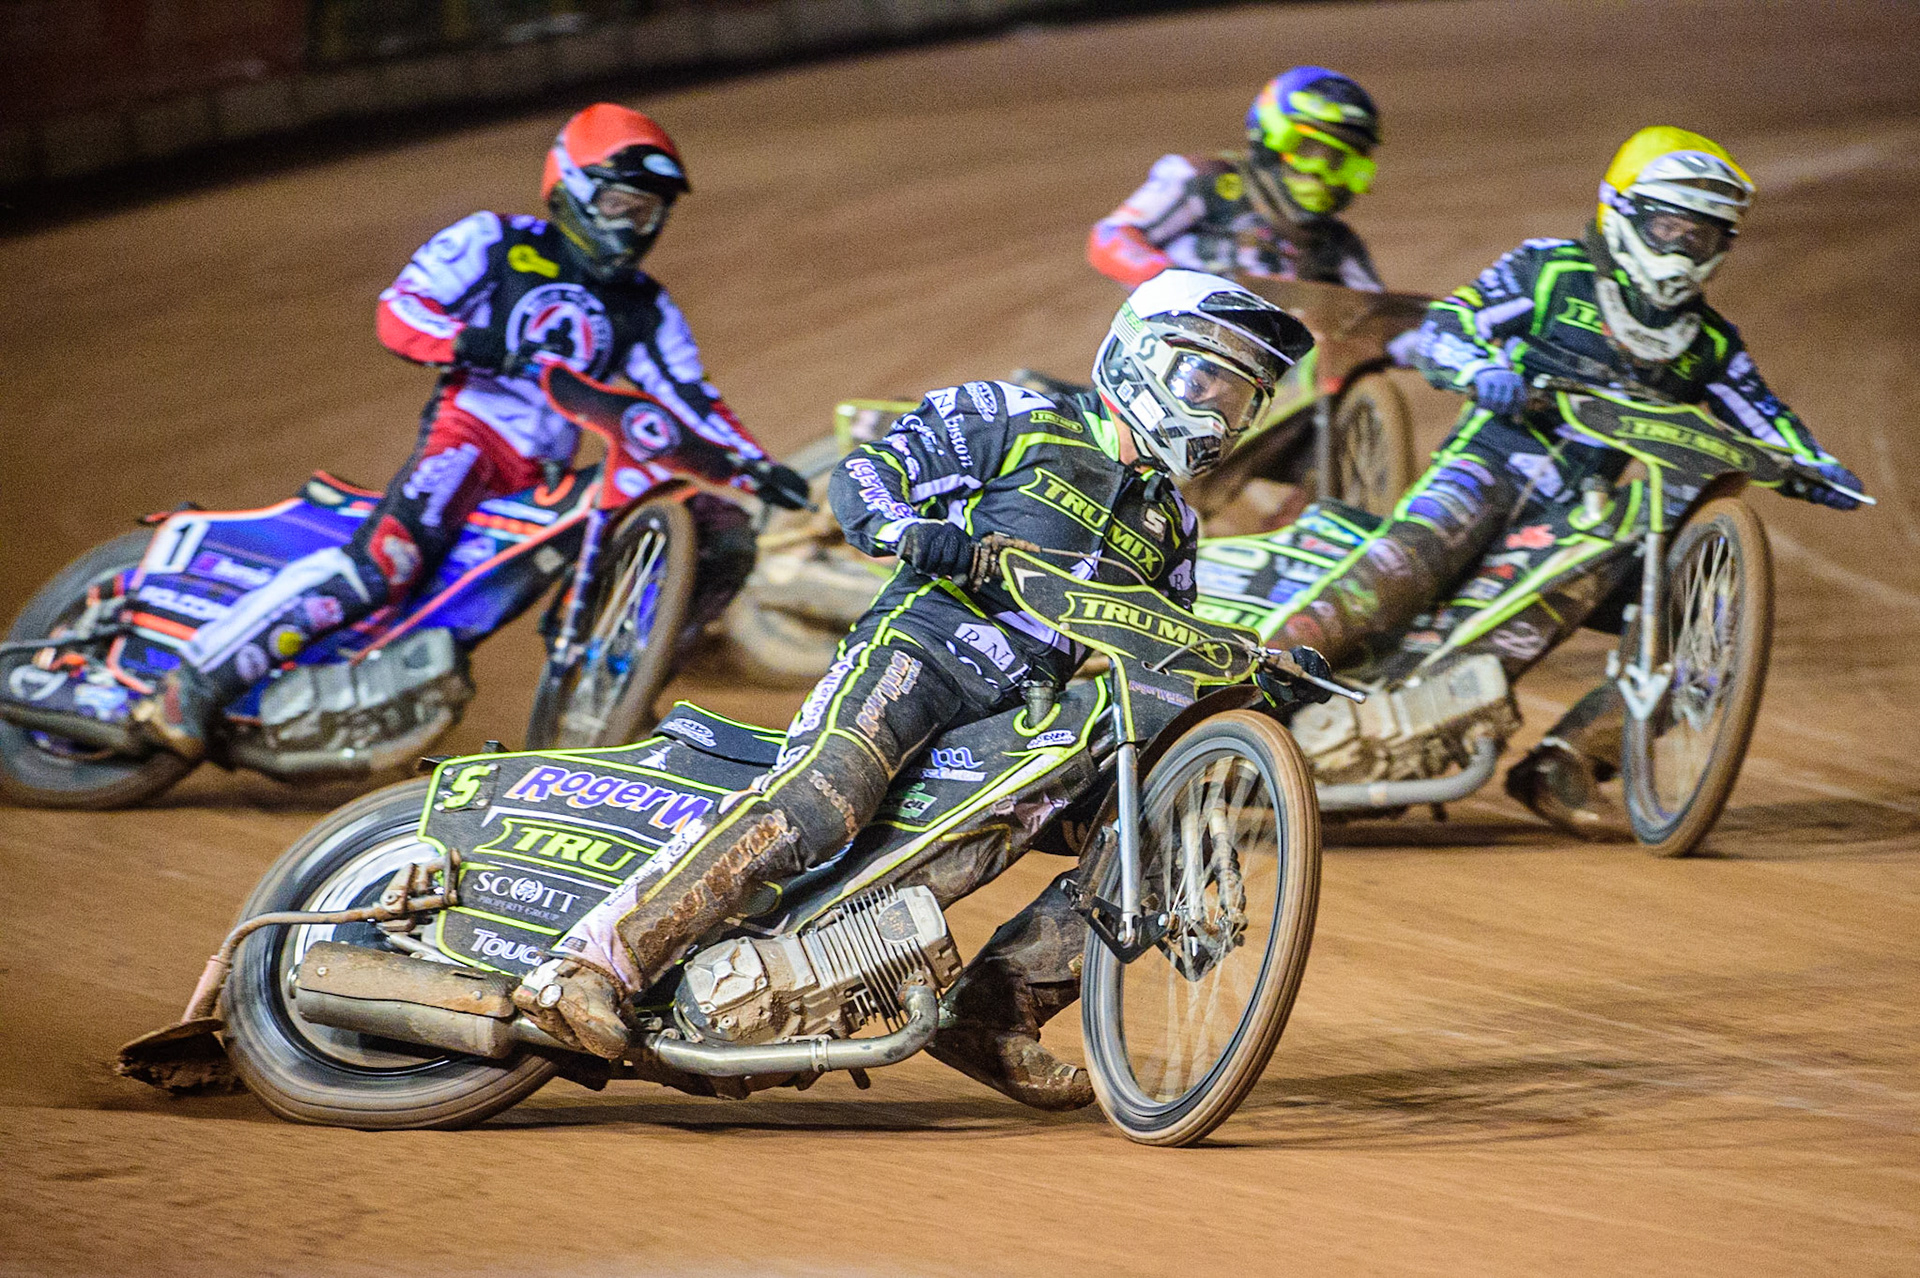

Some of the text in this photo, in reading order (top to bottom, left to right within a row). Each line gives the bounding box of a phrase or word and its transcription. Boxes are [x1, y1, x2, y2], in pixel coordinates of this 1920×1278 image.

[1045, 478, 1111, 529] TRU
[1106, 524, 1160, 573] MIX
[1080, 598, 1153, 631] TRU
[1157, 618, 1221, 662] MIX
[512, 825, 637, 872] TRU
[472, 871, 581, 914] SCOTT
